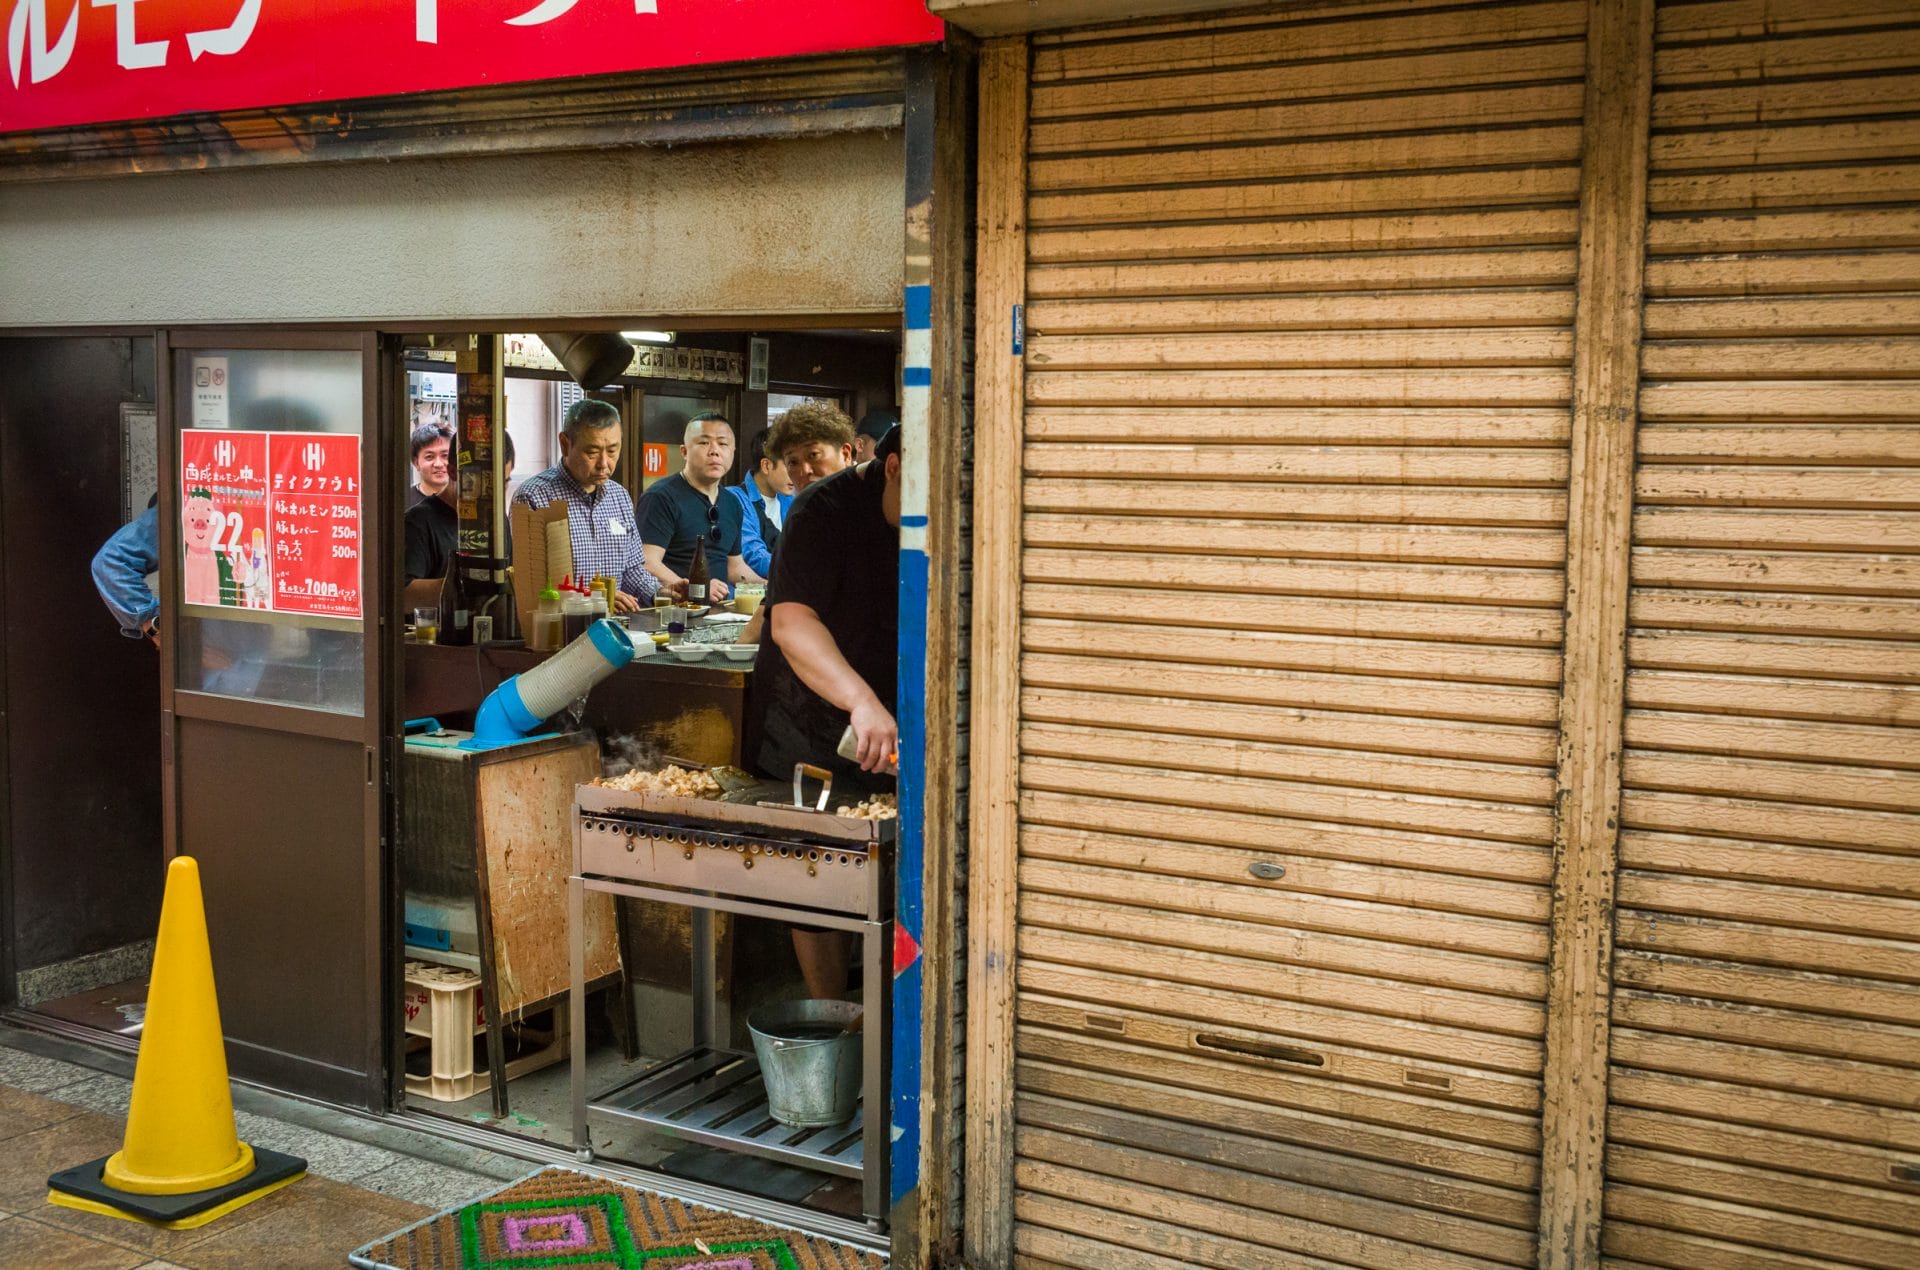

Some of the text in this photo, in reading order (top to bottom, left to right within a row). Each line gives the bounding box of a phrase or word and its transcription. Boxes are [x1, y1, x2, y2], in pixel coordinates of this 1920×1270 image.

[274, 473, 358, 492] テイクアウト
[275, 500, 329, 517] 豚ホルモン
[331, 505, 357, 519] 250円
[275, 520, 357, 539] 豚レバー 250円
[276, 539, 357, 559] 両方 500円
